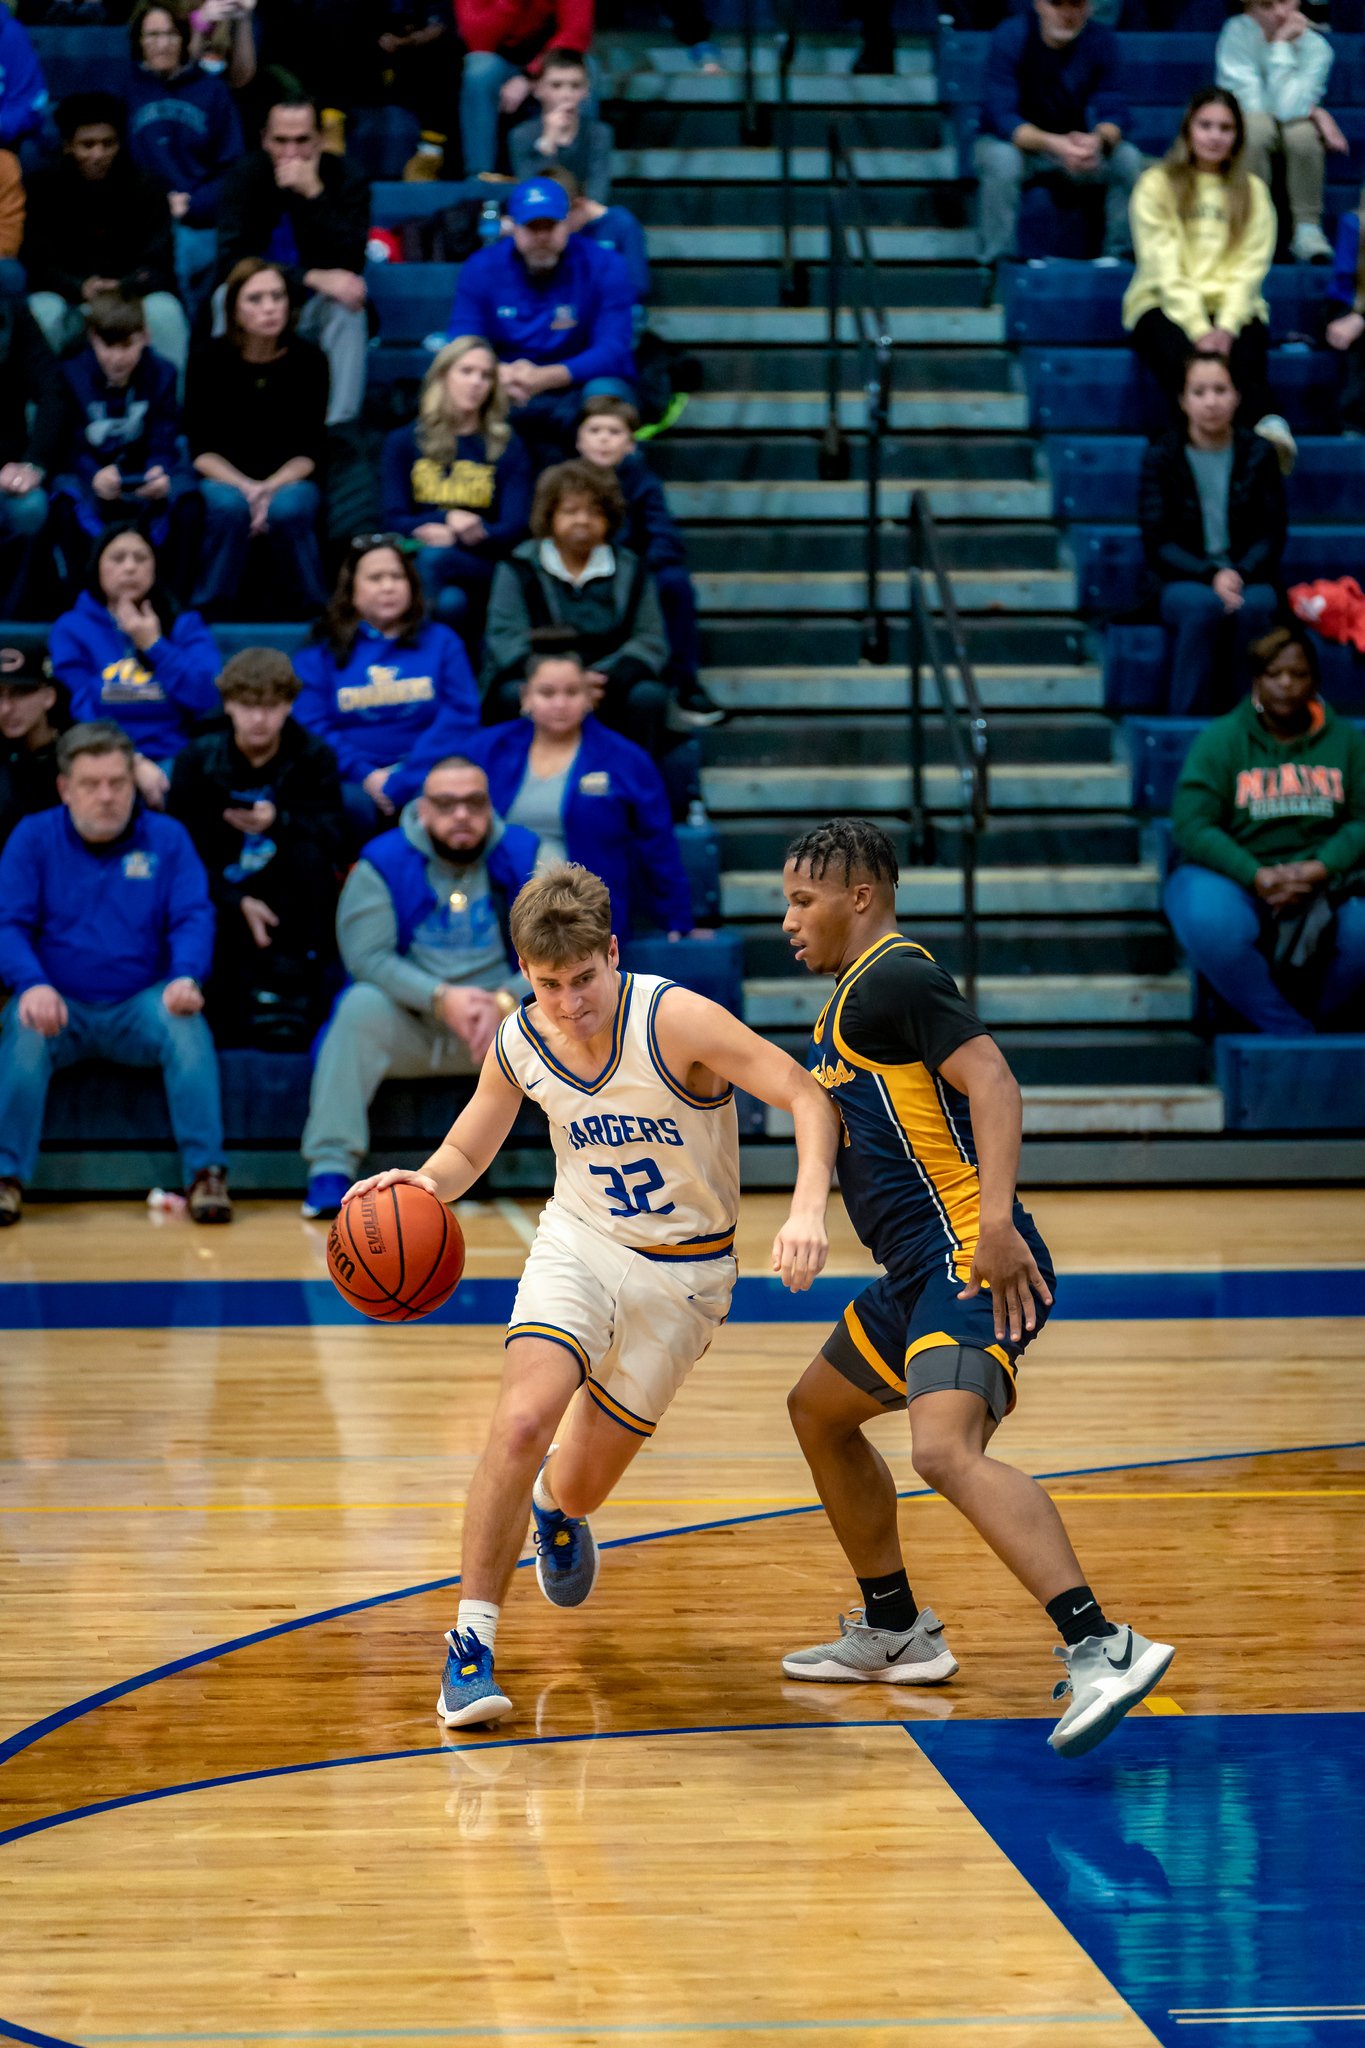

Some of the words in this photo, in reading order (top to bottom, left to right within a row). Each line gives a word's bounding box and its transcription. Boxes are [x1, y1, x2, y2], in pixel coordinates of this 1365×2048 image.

[1235, 763, 1344, 808] MIAMI
[563, 1114, 684, 1151] ARGERS
[588, 1157, 676, 1218] 32
